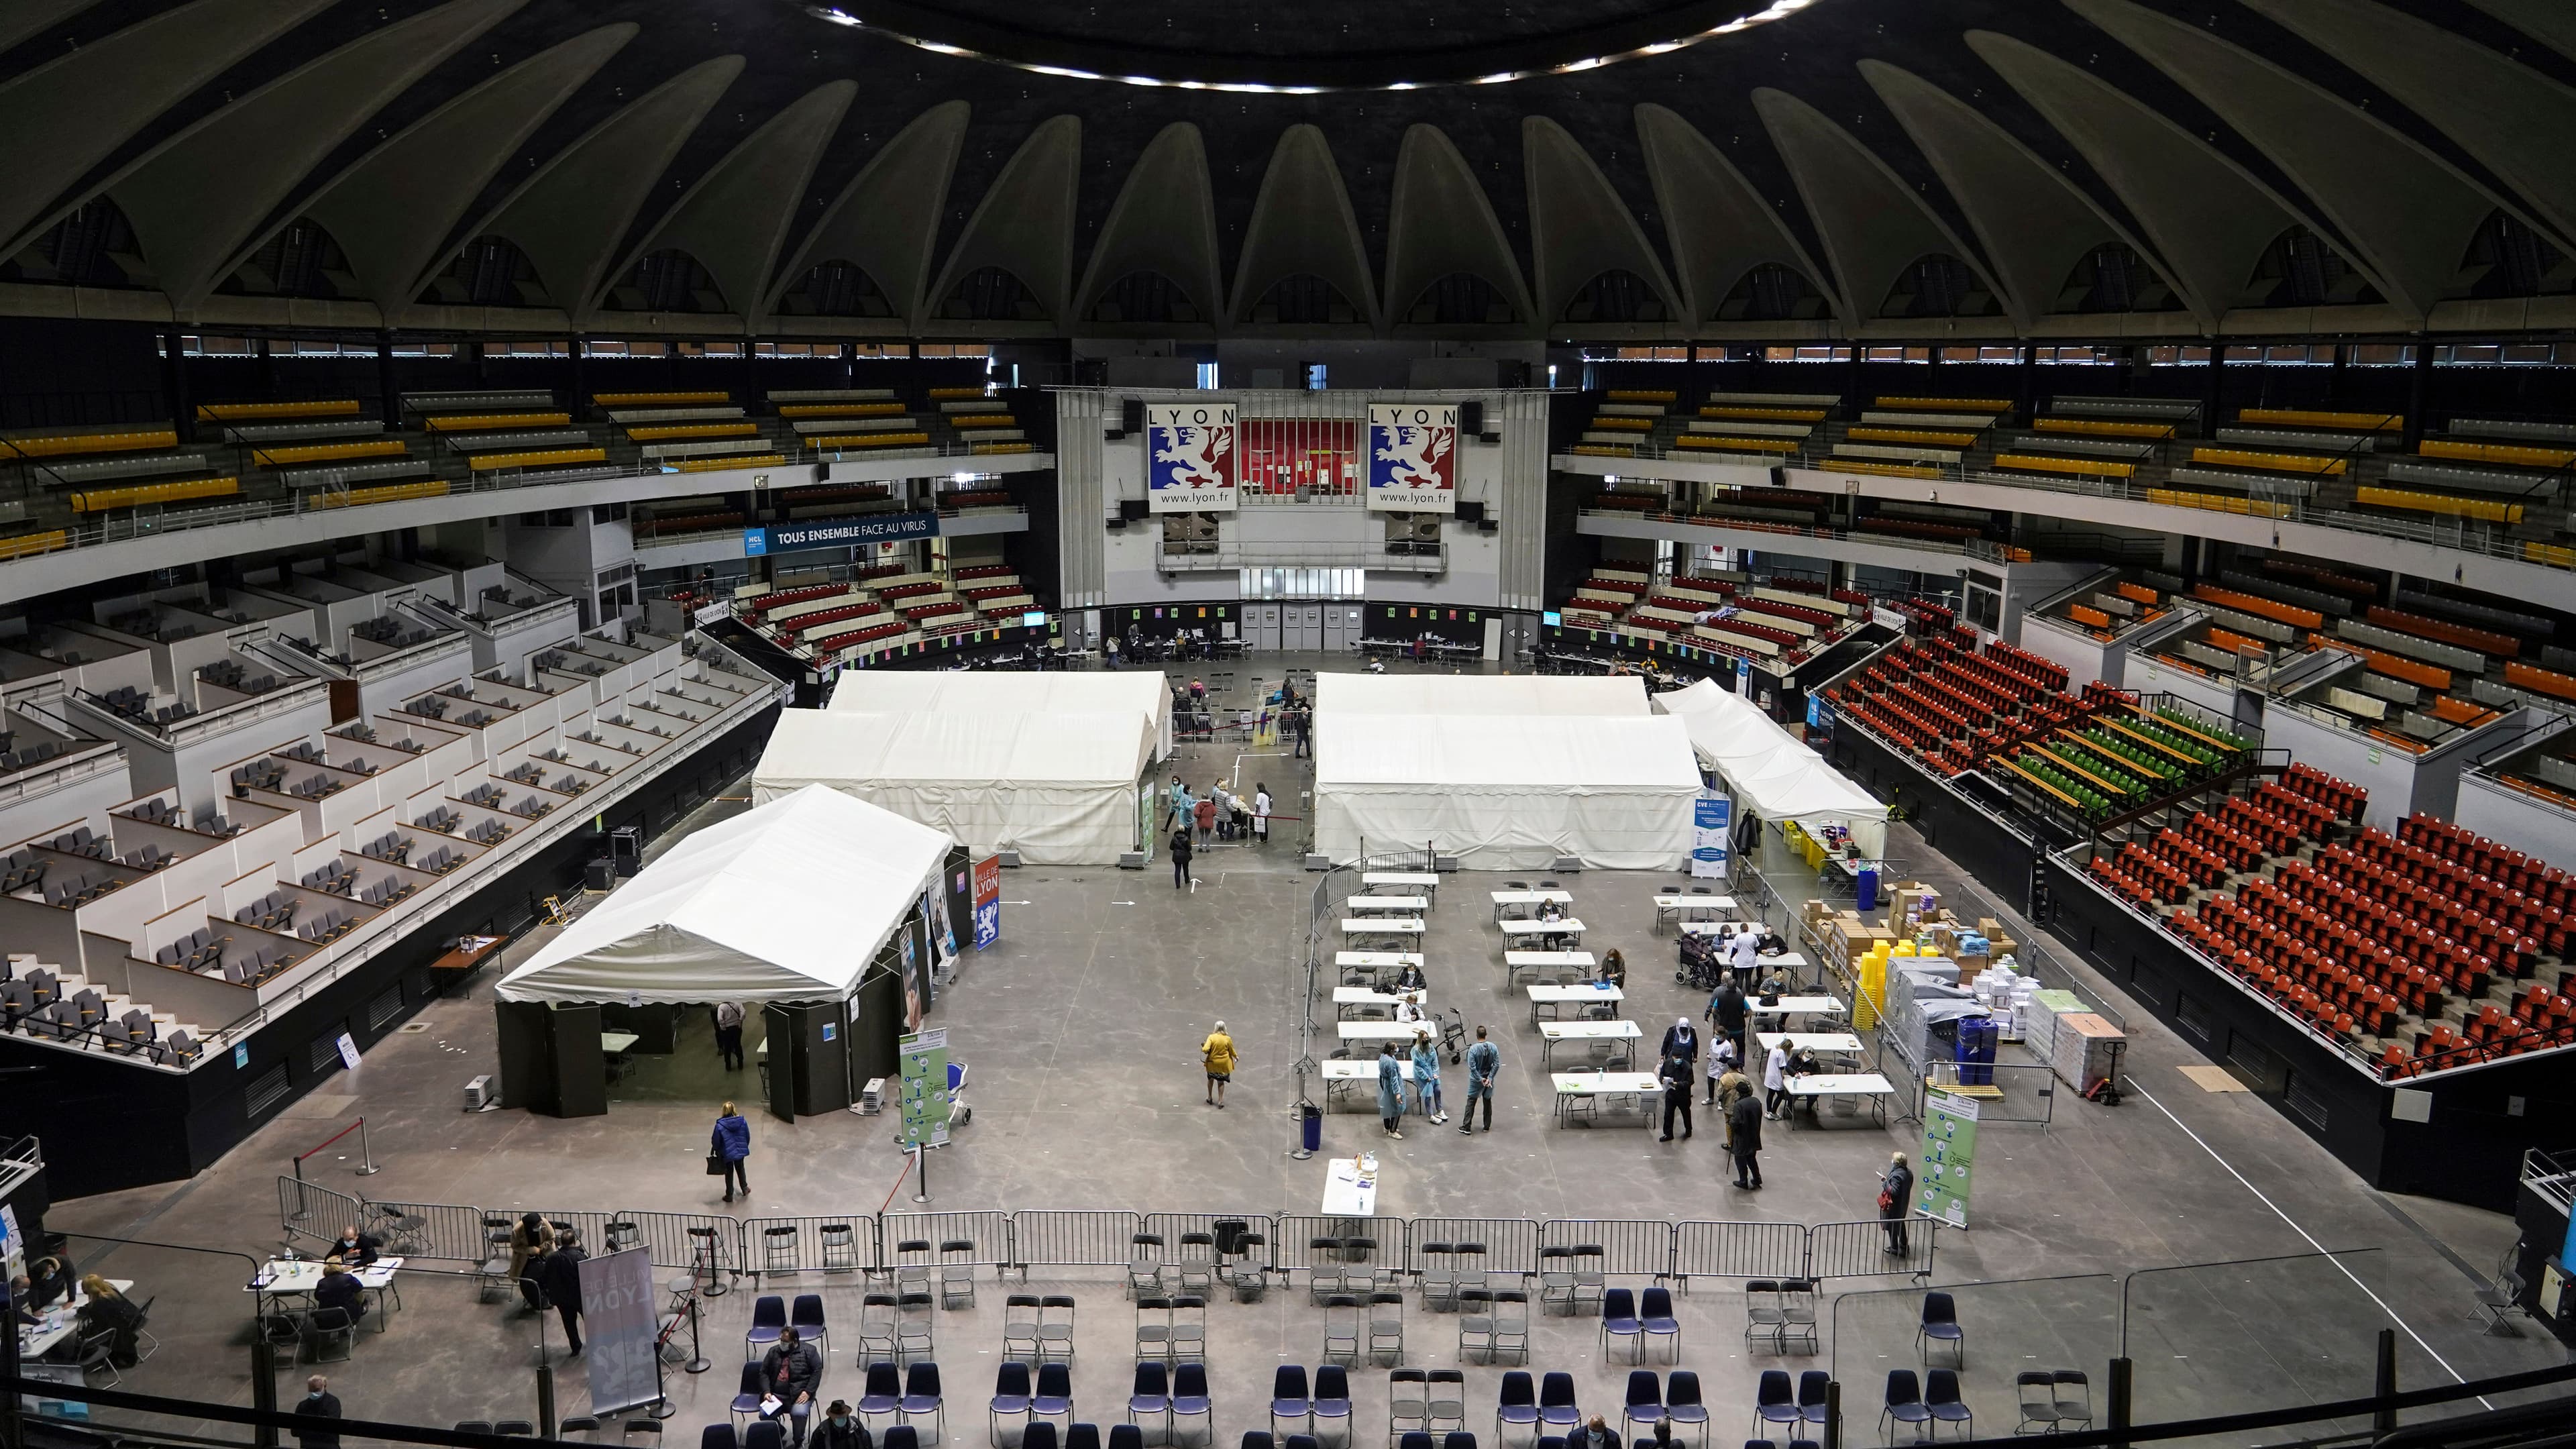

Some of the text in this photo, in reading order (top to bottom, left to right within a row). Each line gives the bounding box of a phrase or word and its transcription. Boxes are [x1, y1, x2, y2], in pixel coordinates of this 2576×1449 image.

[1148, 409, 1234, 425] LYON
[1371, 409, 1455, 425] LYON
[1161, 492, 1228, 504] www.lyon.fr
[1380, 492, 1447, 504] www.lyon.fr
[777, 520, 926, 545] TOUS ENSEMBLE FACE AU VIRUS
[976, 869, 990, 883] VILLE
[991, 865, 998, 875] DE
[977, 874, 998, 898] LYON
